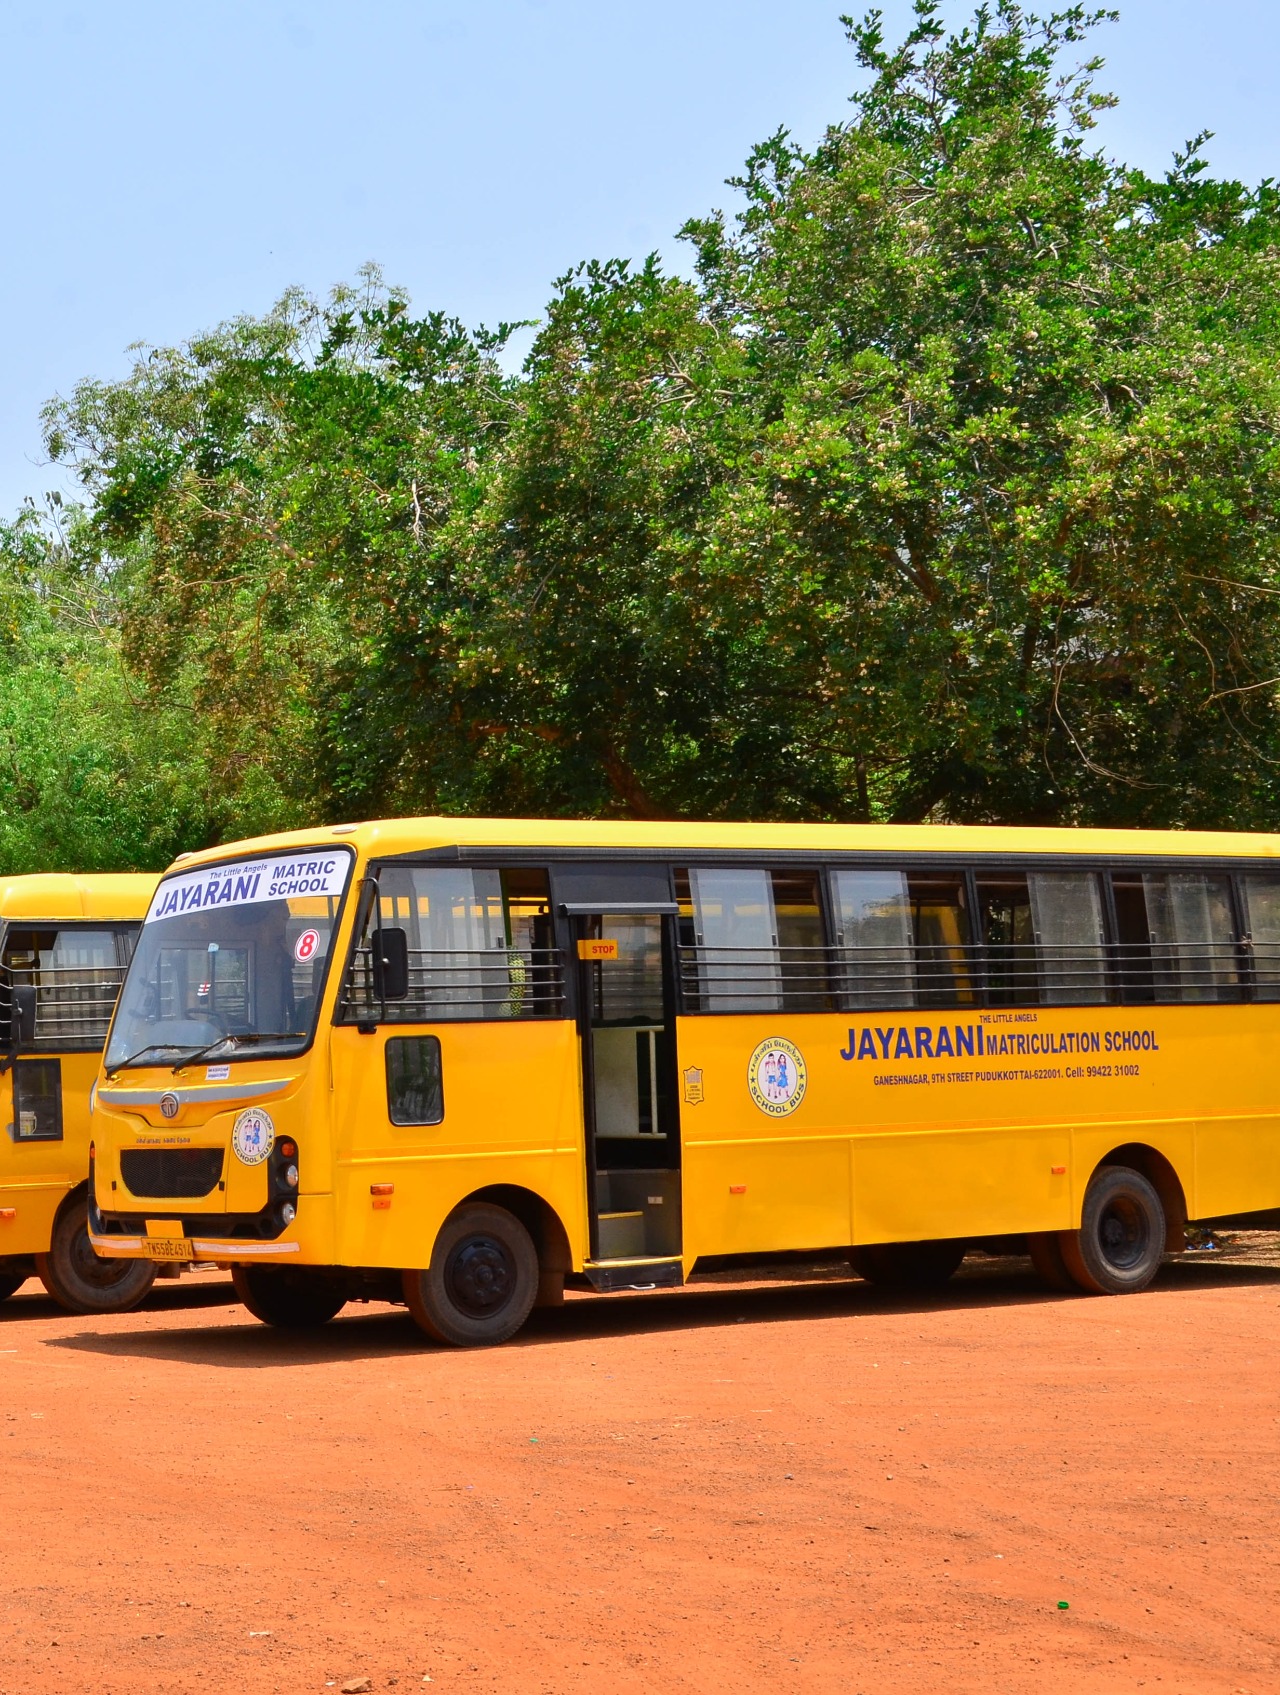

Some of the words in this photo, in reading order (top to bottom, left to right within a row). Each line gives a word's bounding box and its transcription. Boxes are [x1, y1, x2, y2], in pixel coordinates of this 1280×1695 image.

[210, 871, 222, 880] The
[224, 868, 241, 878] Little
[243, 863, 268, 875] Angels
[272, 860, 336, 880] MATRIC
[155, 873, 261, 917] JAYARANI
[268, 877, 329, 896] SCHOOL
[299, 934, 315, 957] 8
[592, 945, 614, 954] STOP
[979, 1015, 991, 1023] THE
[993, 1014, 1013, 1023] LITTLE
[1014, 1013, 1038, 1022] ANGELS
[840, 1025, 984, 1061] JAYARANI
[986, 1031, 1100, 1056] MATRICULATION
[1104, 1030, 1159, 1052] SCHOOL
[873, 1073, 930, 1086] GANESHNAGAR,
[931, 1072, 945, 1083] 9TH
[947, 1071, 974, 1083] STREET
[1065, 1067, 1084, 1078] Cell:
[1086, 1065, 1112, 1077] 99422
[1114, 1064, 1140, 1076] 31002
[751, 1086, 788, 1113] SCHOOL
[789, 1083, 805, 1108] BUS
[233, 1143, 258, 1163] SCHOOL
[259, 1141, 273, 1159] BUS
